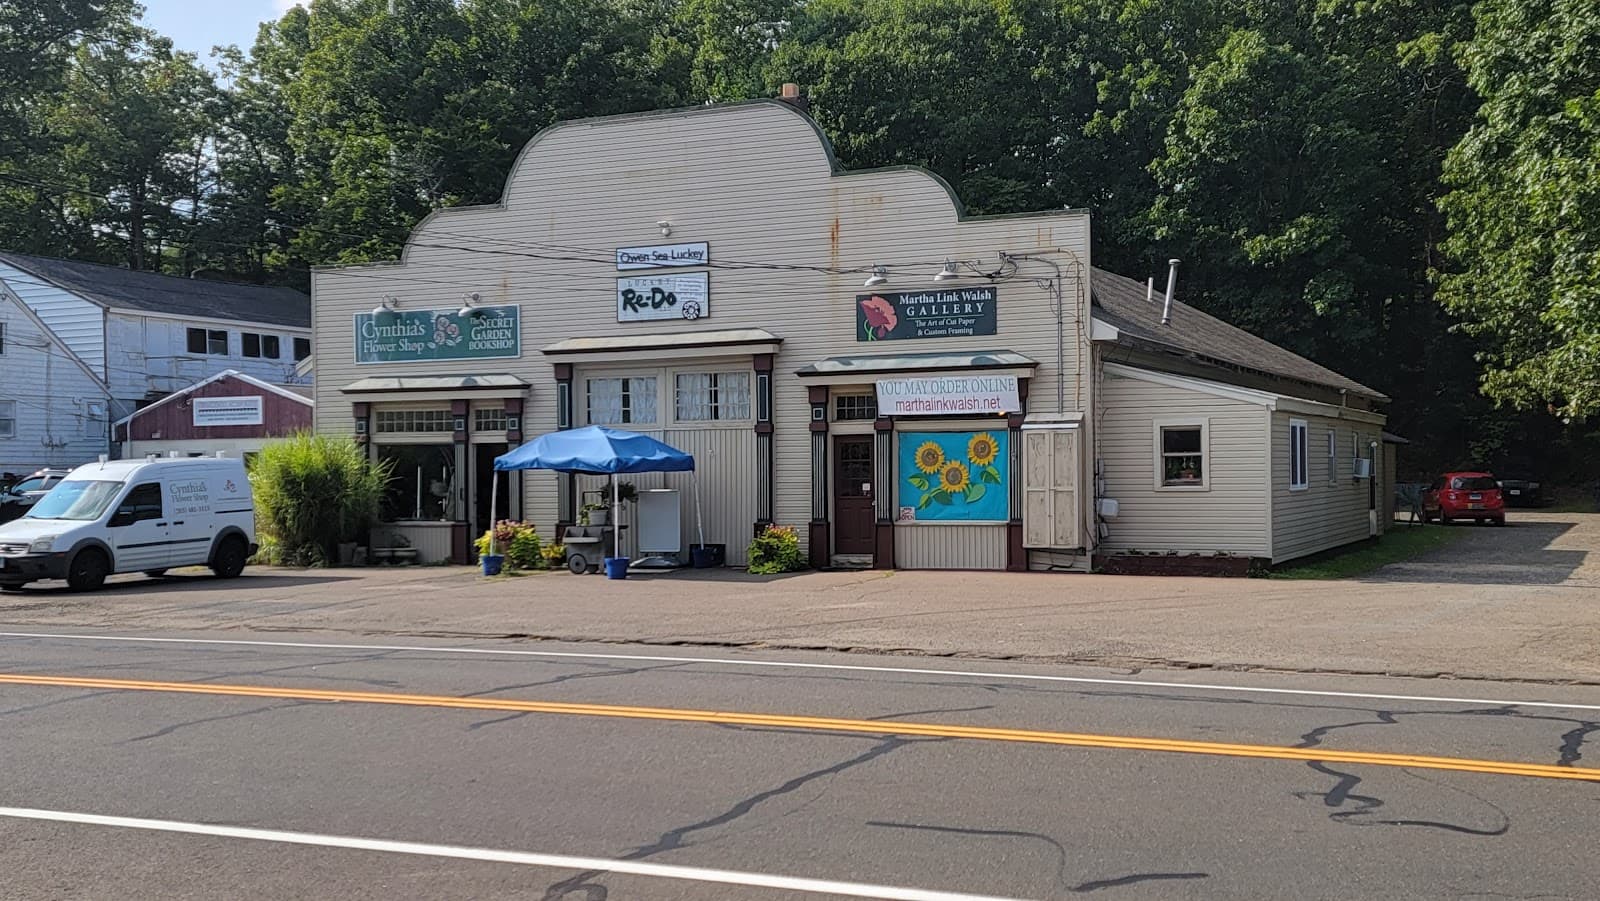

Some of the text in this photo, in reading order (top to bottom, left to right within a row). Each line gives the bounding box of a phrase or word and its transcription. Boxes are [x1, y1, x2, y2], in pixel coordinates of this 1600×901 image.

[621, 248, 704, 263] Owen Sea Luckey
[621, 287, 677, 313] Re-Do
[899, 290, 992, 305] Martha Link Walsh
[906, 303, 985, 316] GALLERY
[479, 315, 515, 329] SECRET
[915, 318, 976, 328] The Art of Cut Paper
[362, 318, 426, 343] Cynthia's
[471, 327, 512, 341] GARDEN
[917, 327, 974, 336] & Custom Framing
[364, 339, 425, 354] Flower Shop
[468, 340, 515, 351] BOOKSHOP
[879, 378, 1016, 396] YOU MAY ORDER ONLINE
[895, 396, 1001, 413] marthalinkwalsh.net
